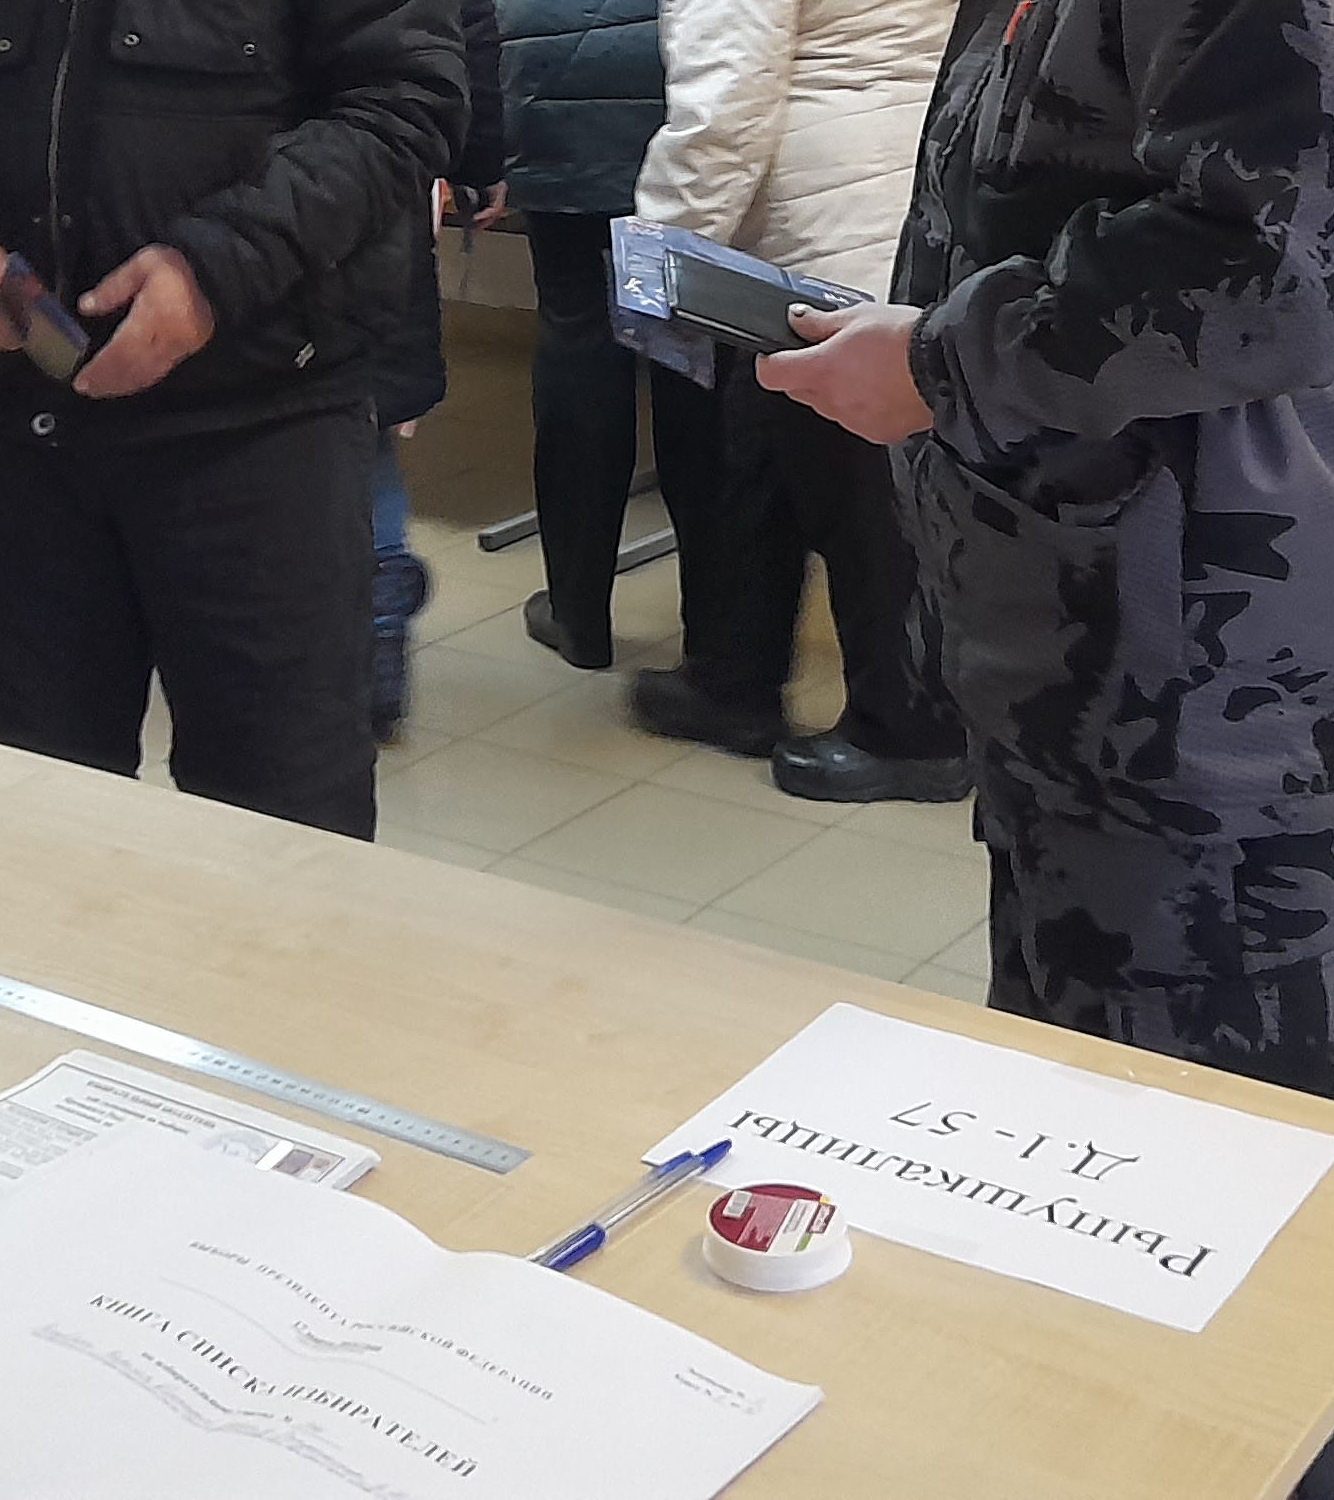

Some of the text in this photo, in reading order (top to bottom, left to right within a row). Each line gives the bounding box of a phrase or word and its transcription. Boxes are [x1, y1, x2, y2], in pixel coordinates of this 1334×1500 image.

[728, 1107, 1215, 1279] Рыпушкалицы
[886, 1098, 979, 1137] 57
[89, 1293, 172, 1334] КНИГА
[174, 1328, 279, 1396] СПИСКА
[281, 1382, 480, 1479] ИЗБИРАТЕЛЕЙ
